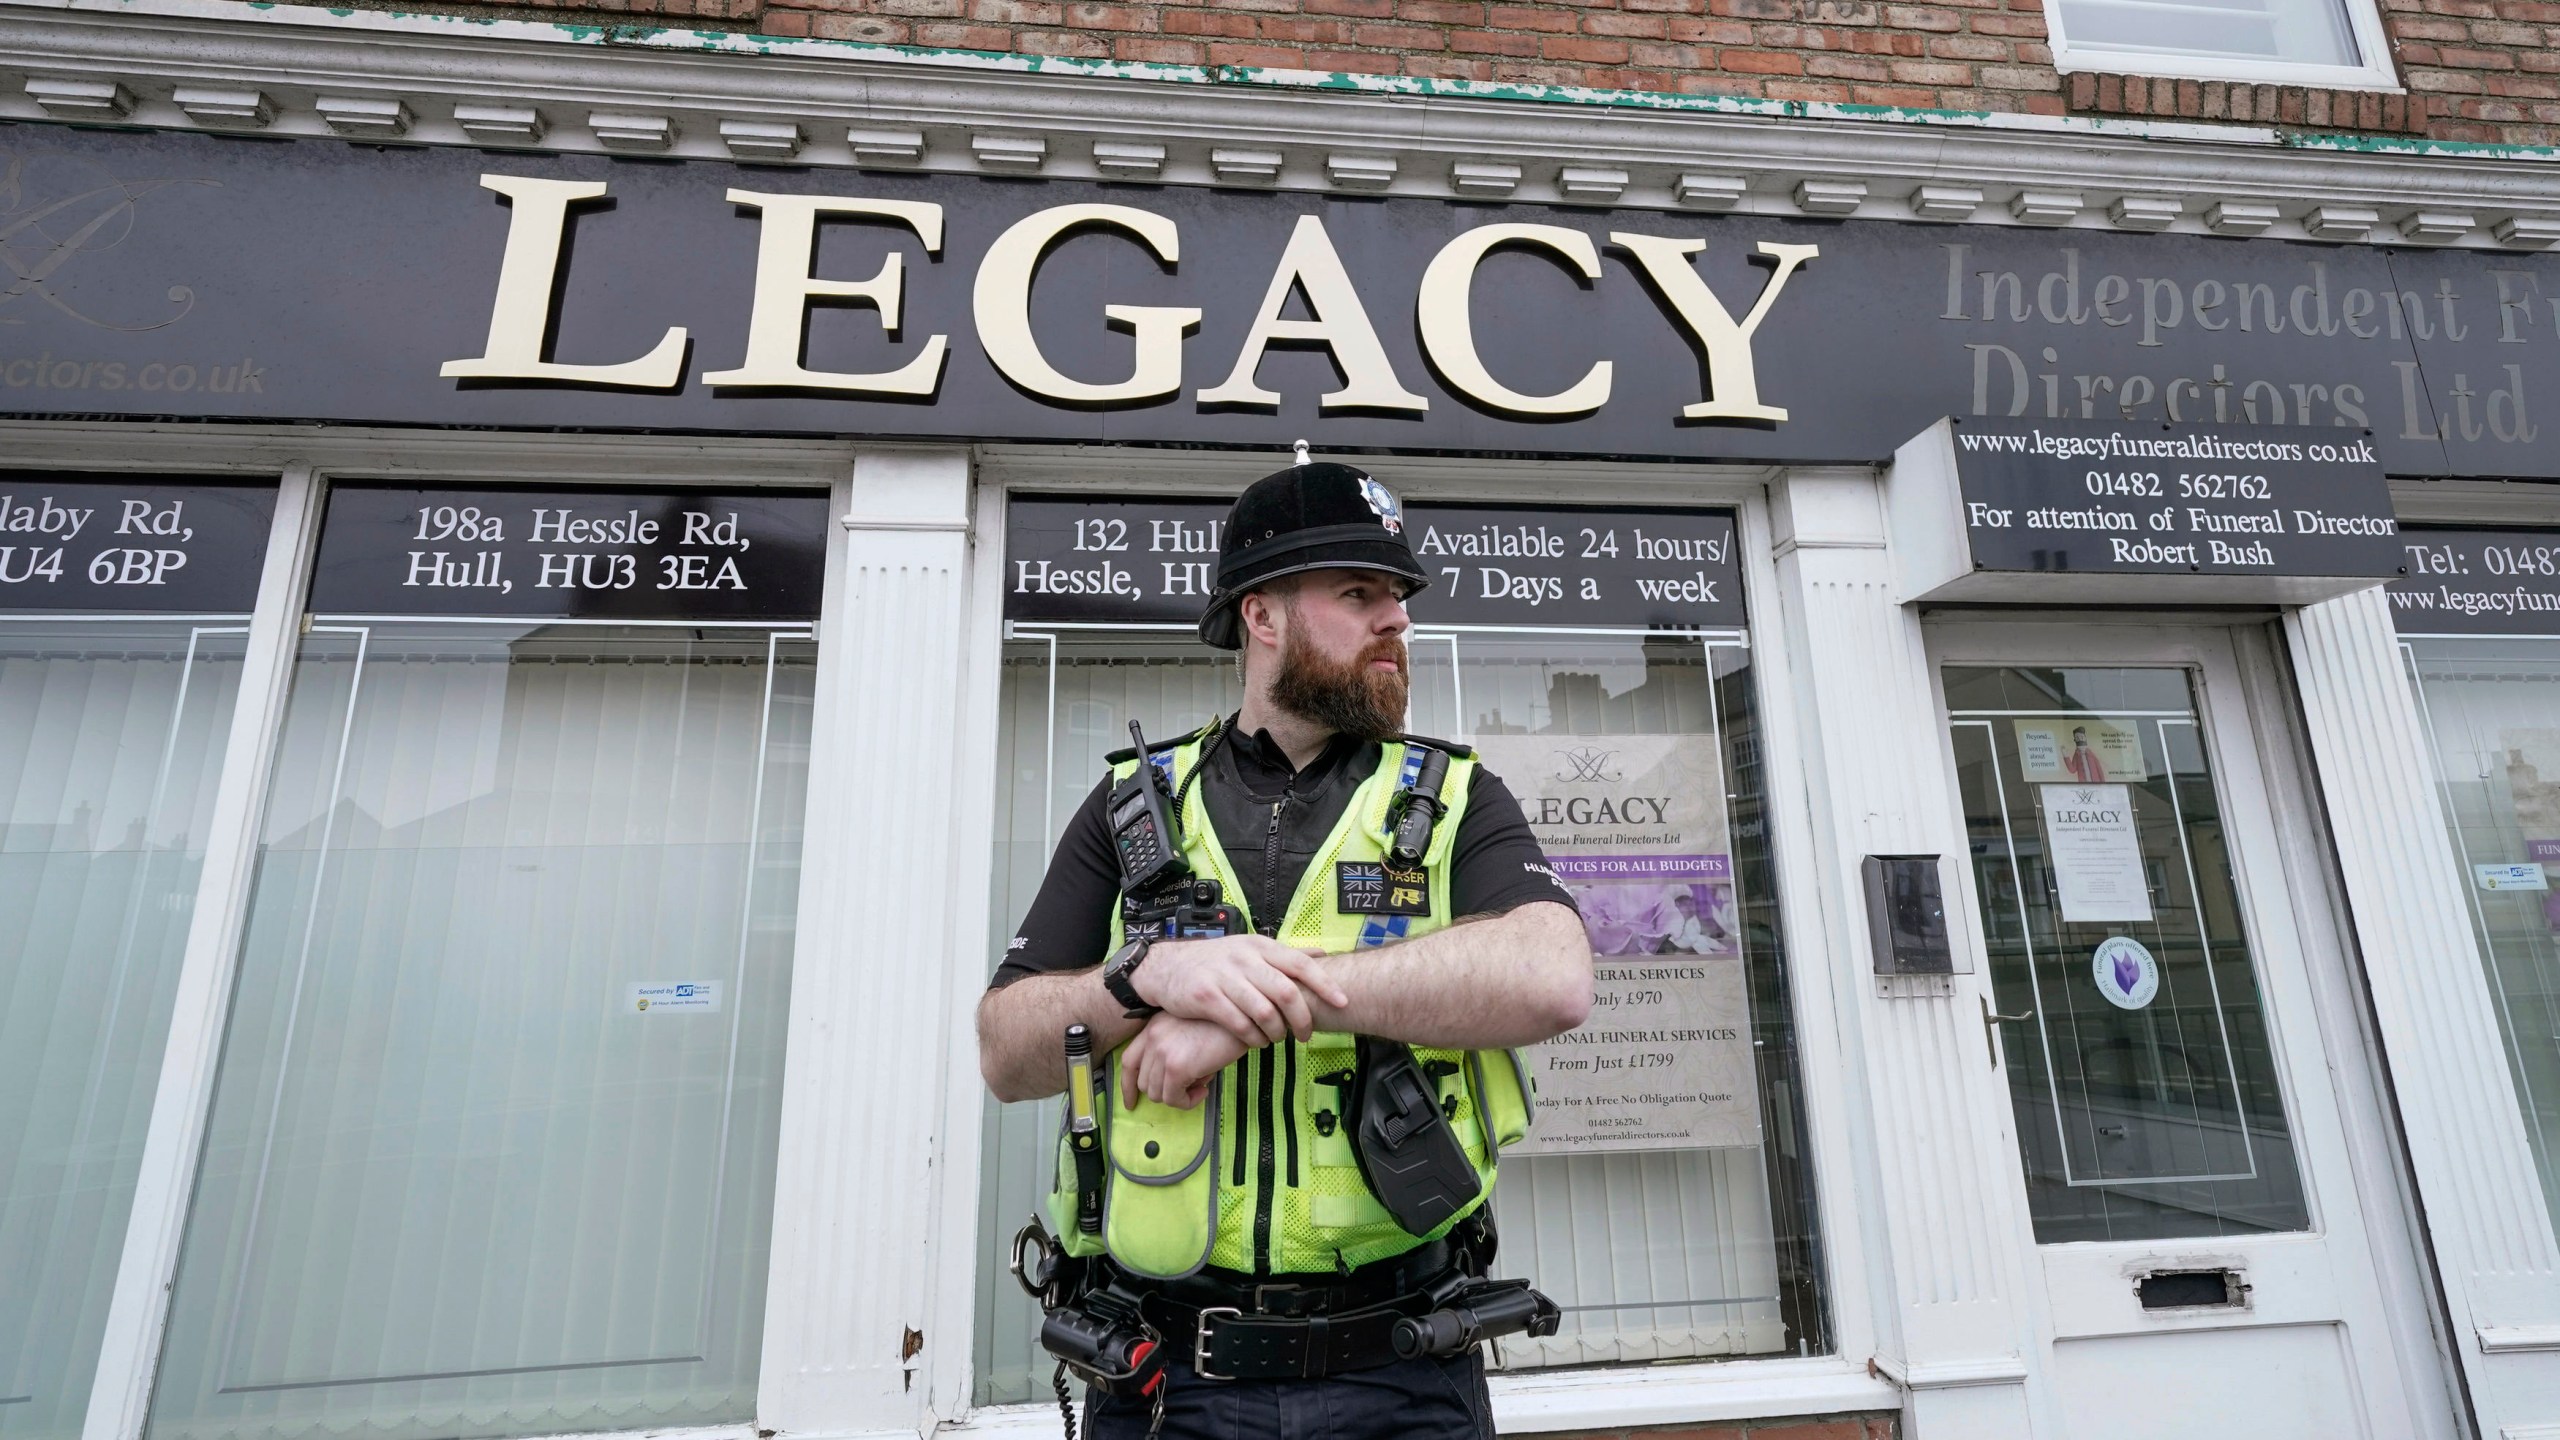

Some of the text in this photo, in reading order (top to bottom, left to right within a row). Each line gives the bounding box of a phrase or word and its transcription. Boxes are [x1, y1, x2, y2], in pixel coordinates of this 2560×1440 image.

[440, 172, 1818, 423] LEGACY
[1939, 243, 2560, 348] Independent F
[0, 352, 265, 393] ctors.co.uk
[1965, 343, 2538, 443] Directors Ltd
[2309, 439, 2377, 463] co.uk
[2086, 471, 2272, 499] 01482 562762
[0, 495, 193, 542] laby Rd,
[413, 506, 750, 552] 198a Hessle Rd,
[1968, 503, 2395, 536] For attention of Funeral Director
[1073, 519, 1228, 552] 132 Hul
[1417, 525, 1729, 565] Available 24 hours/
[0, 546, 187, 585] U4 6BP
[2110, 538, 2275, 565] Robert Bush
[2405, 545, 2469, 575] Tel:
[402, 551, 748, 595] Hull, HU3 3EA
[1014, 560, 1142, 601] Hessle,
[1440, 567, 1720, 606] 7 Days a week
[2386, 585, 2560, 615] ww.legacyfun
[2055, 810, 2121, 823] LEGACY
[1535, 833, 1681, 846] endent Funeral Directors Ltd
[1601, 861, 1629, 873] FOR
[1631, 861, 1656, 872] ALL
[1660, 860, 1723, 872] BUDGETS
[1154, 895, 1179, 907] Police
[1346, 893, 1382, 908] 1727
[1639, 967, 1705, 980] SERVICES
[676, 985, 694, 996] ADT
[1626, 991, 1662, 1005] £970
[1538, 1029, 1737, 1046] IONAL FUNERAL SERVICES
[1549, 1054, 1674, 1073] From Just £1799
[1564, 1096, 1583, 1107] For
[1585, 1096, 1595, 1106] A
[1596, 1095, 1619, 1105] Free
[1621, 1094, 1637, 1105] No
[1639, 1093, 1697, 1108] Obligation
[1699, 1092, 1732, 1104] Quote
[1588, 1117, 1643, 1127] 01482 562762
[1540, 1130, 1691, 1144] www.legacyfuneraldirectors.co.uk
